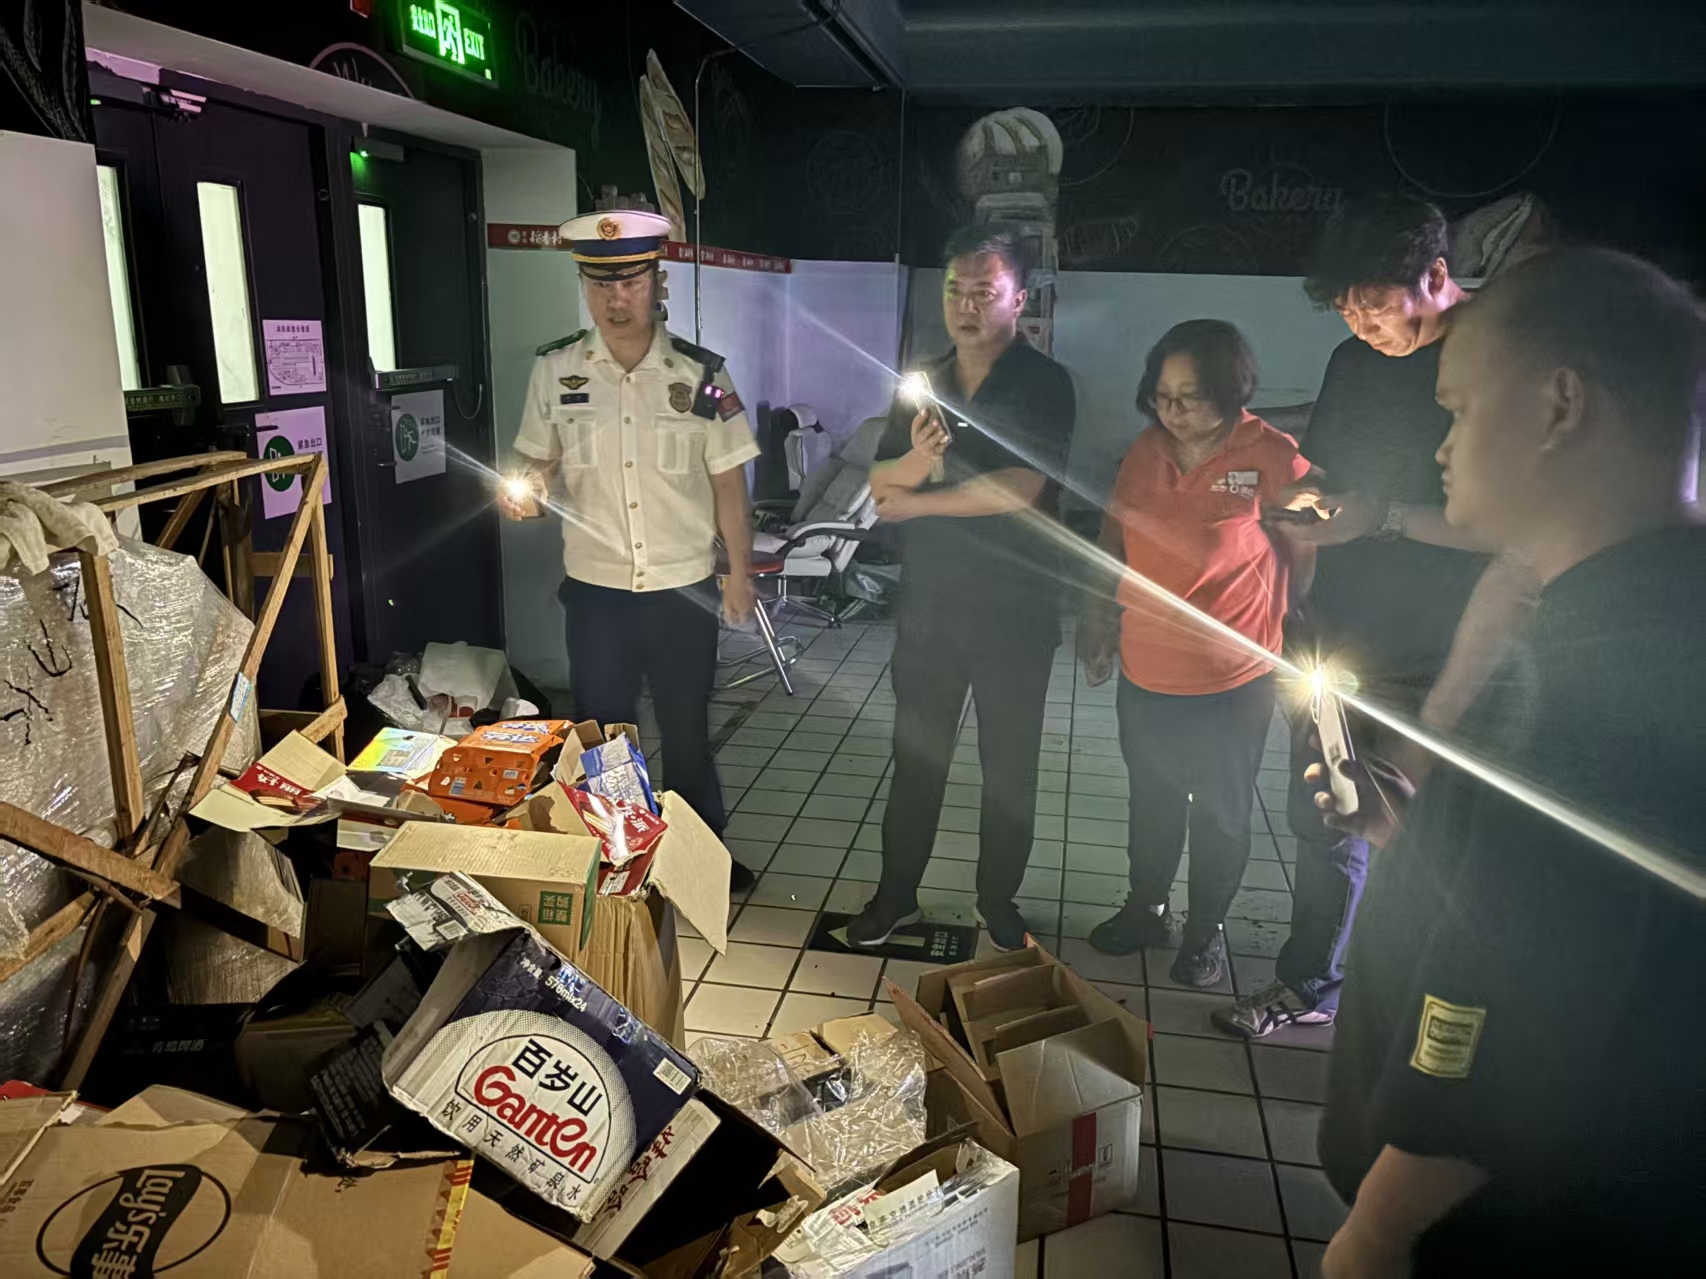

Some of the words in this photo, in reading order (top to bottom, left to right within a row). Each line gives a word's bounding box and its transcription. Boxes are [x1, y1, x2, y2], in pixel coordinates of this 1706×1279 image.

[463, 28, 485, 60] EXIT
[1220, 167, 1345, 222] Bakery
[511, 1038, 604, 1117] 百岁山
[440, 1099, 584, 1201] 饮用天然矿泉水
[473, 1065, 598, 1174] Ganten
[118, 1168, 186, 1225] Lay's
